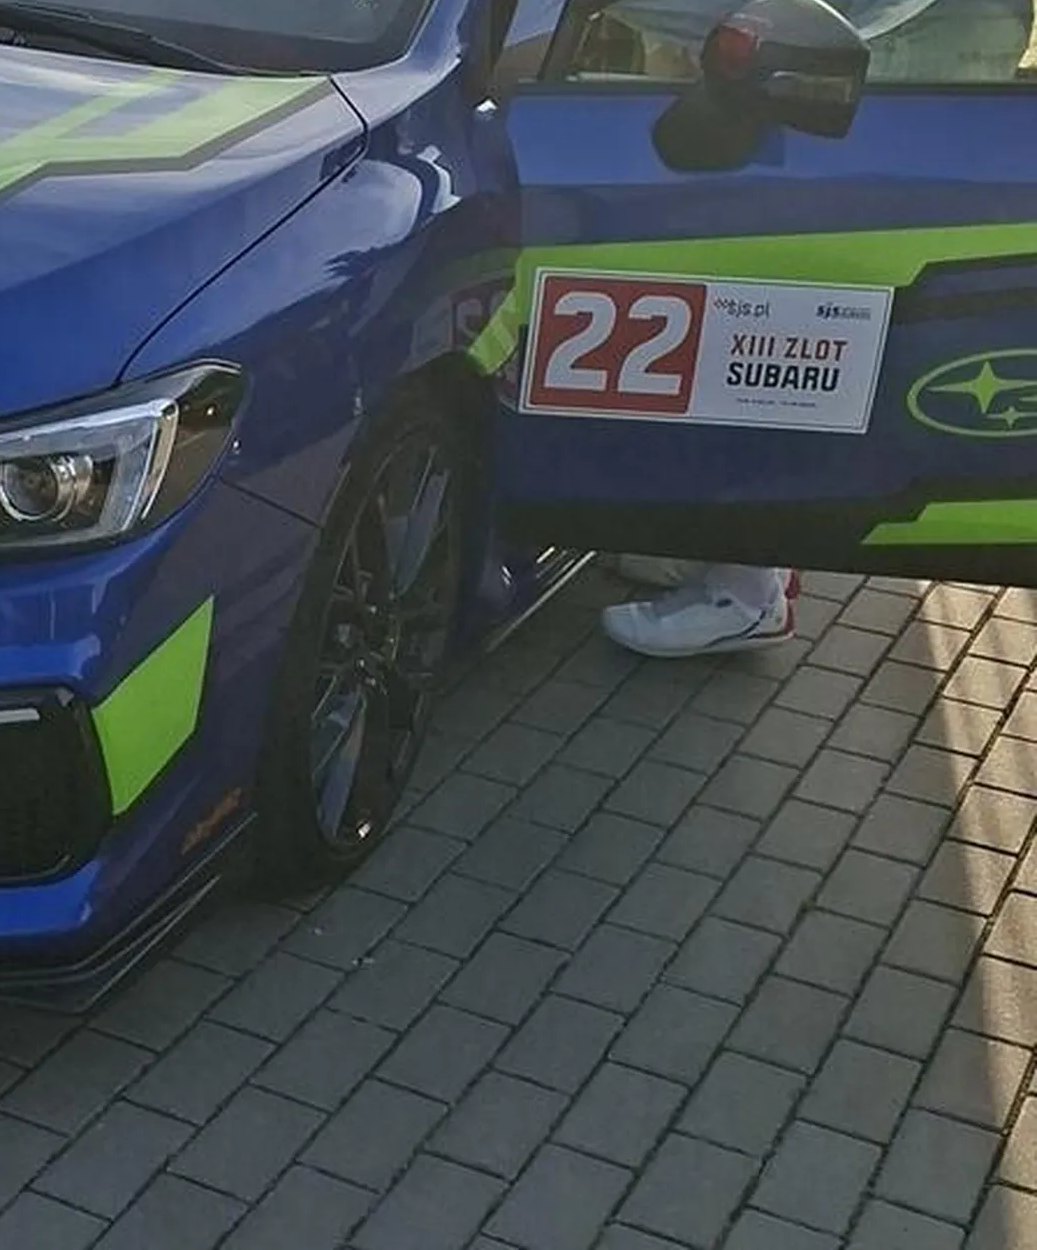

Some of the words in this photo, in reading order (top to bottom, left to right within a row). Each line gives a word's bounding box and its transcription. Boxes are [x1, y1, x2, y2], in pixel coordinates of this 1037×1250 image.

[544, 291, 692, 396] 22
[730, 334, 776, 357] XIII
[784, 337, 848, 362] ZLOT
[726, 361, 841, 393] SUBARU
